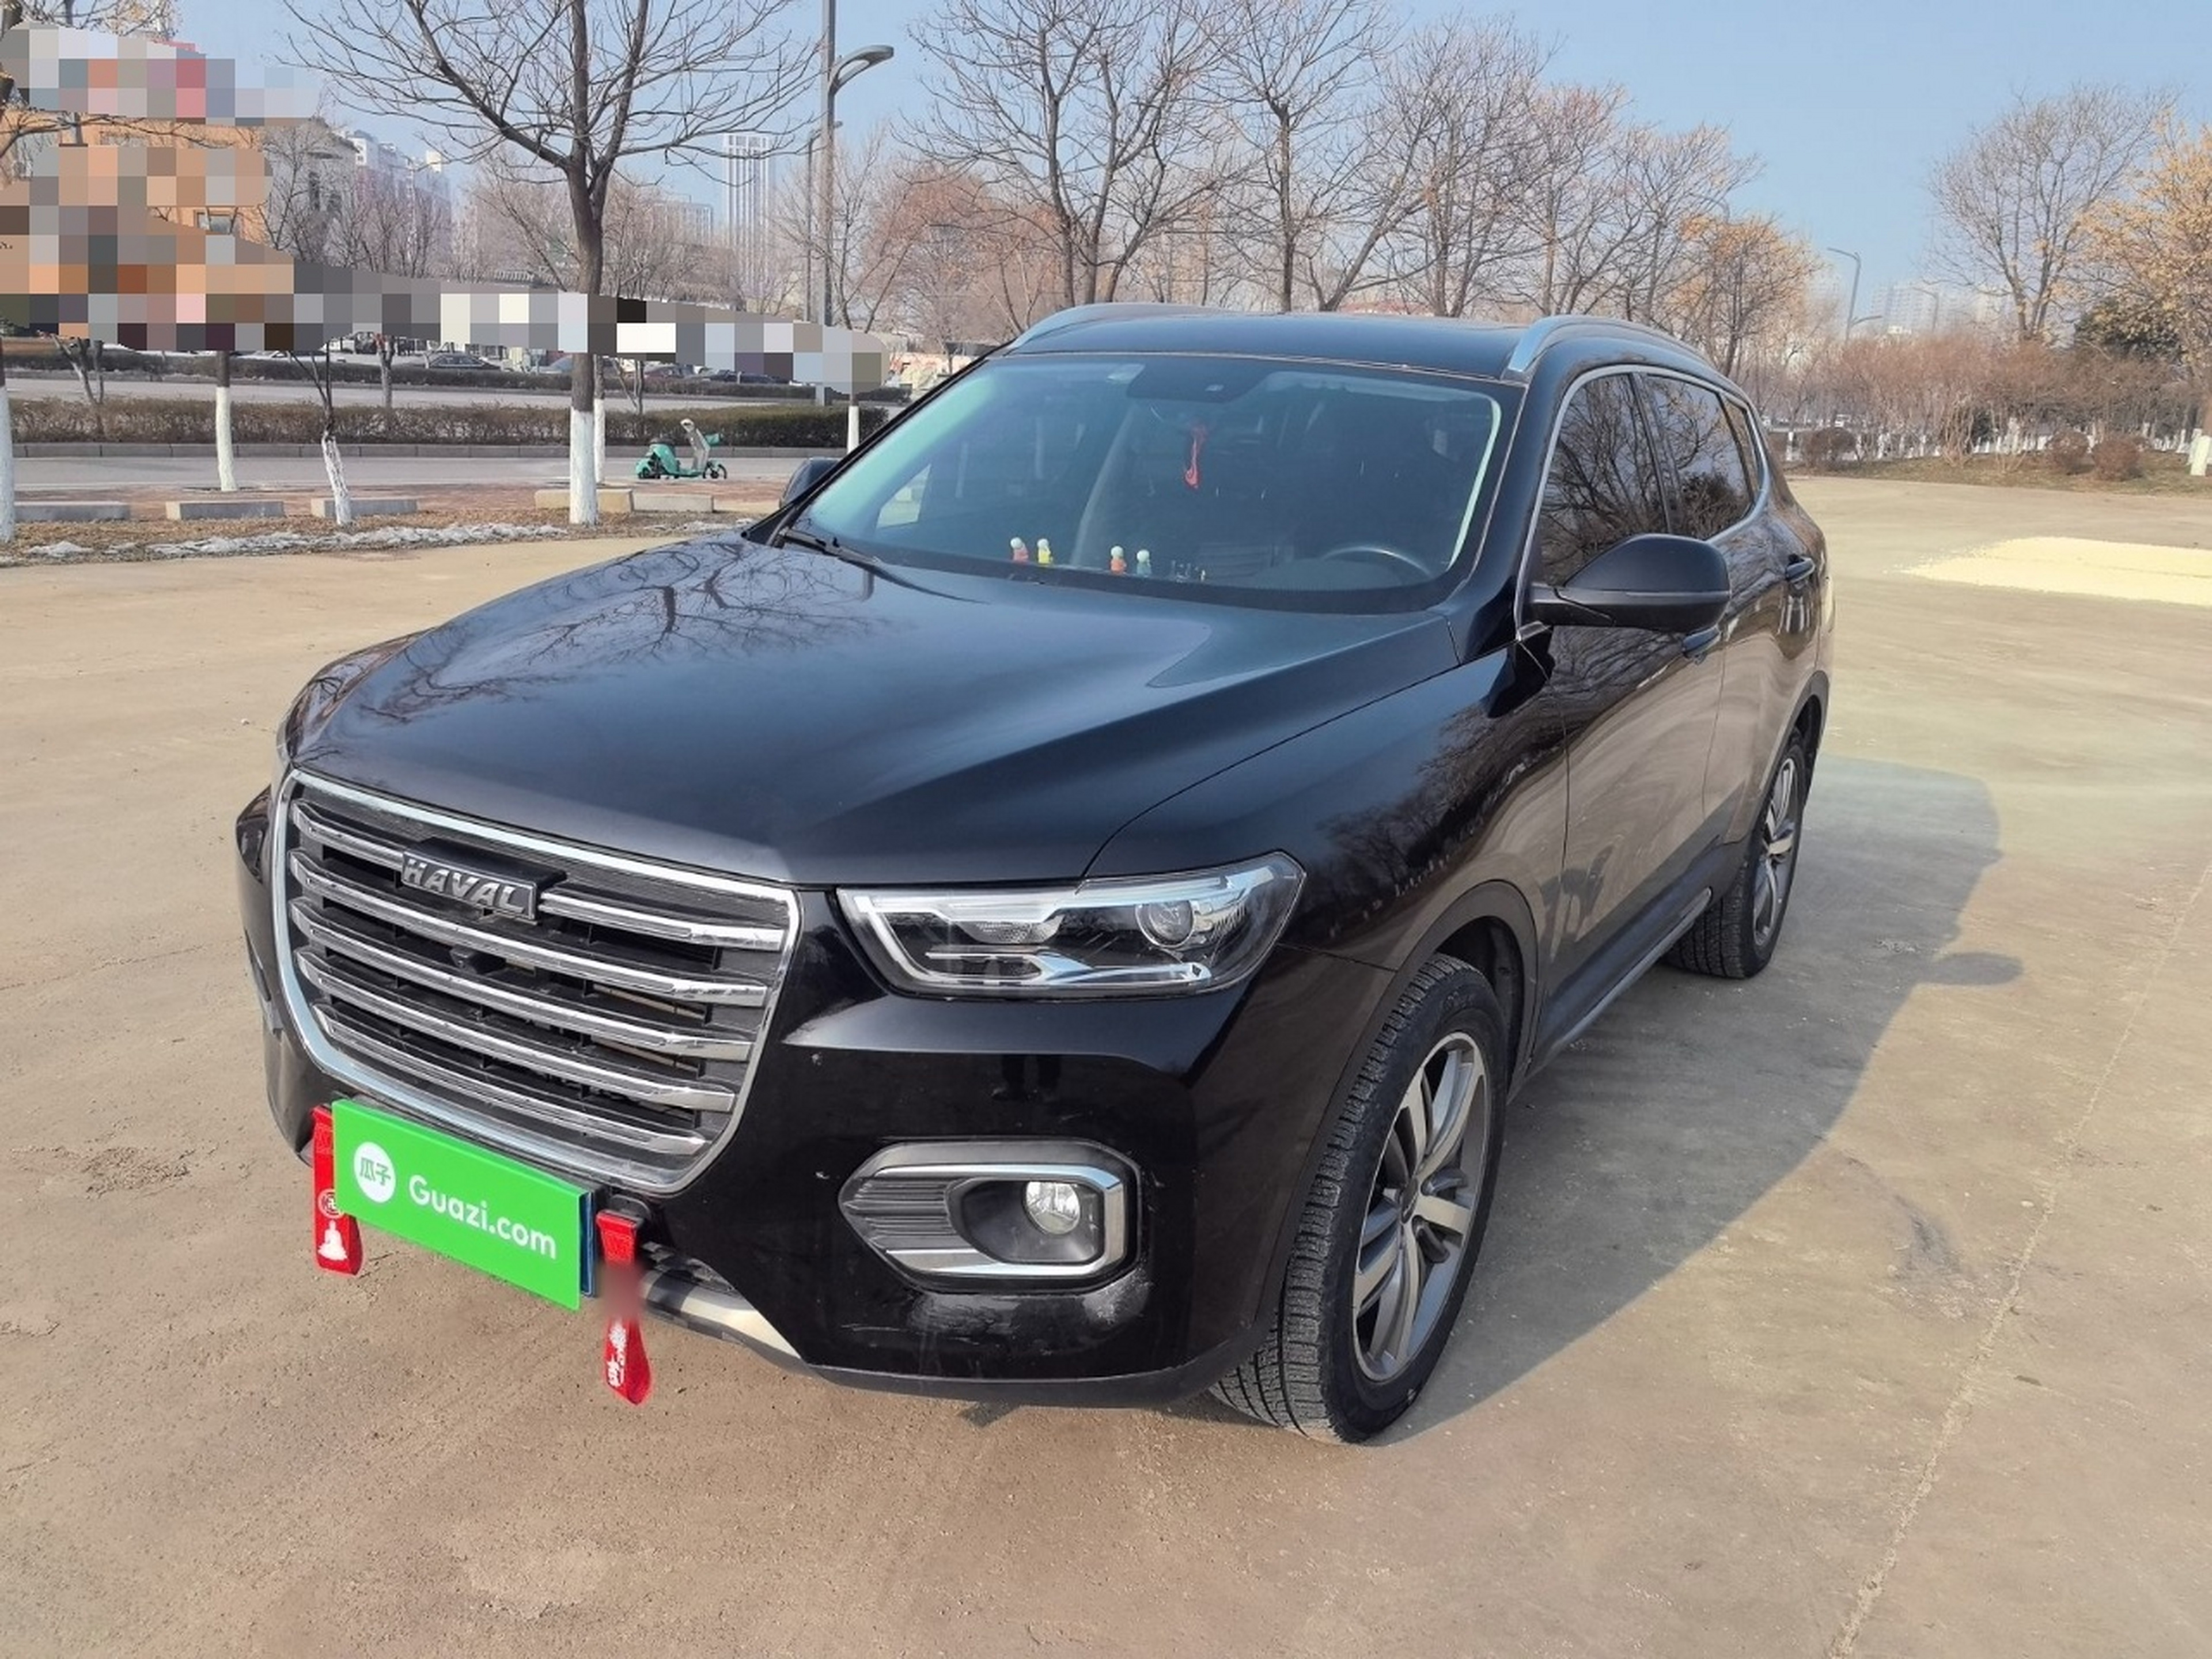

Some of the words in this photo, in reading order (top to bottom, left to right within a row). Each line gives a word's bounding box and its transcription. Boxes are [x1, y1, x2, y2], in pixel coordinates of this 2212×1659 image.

[403, 858, 526, 914] HAVAL
[360, 1157, 391, 1186] 瓜子
[409, 1174, 556, 1260] Guazi.com
